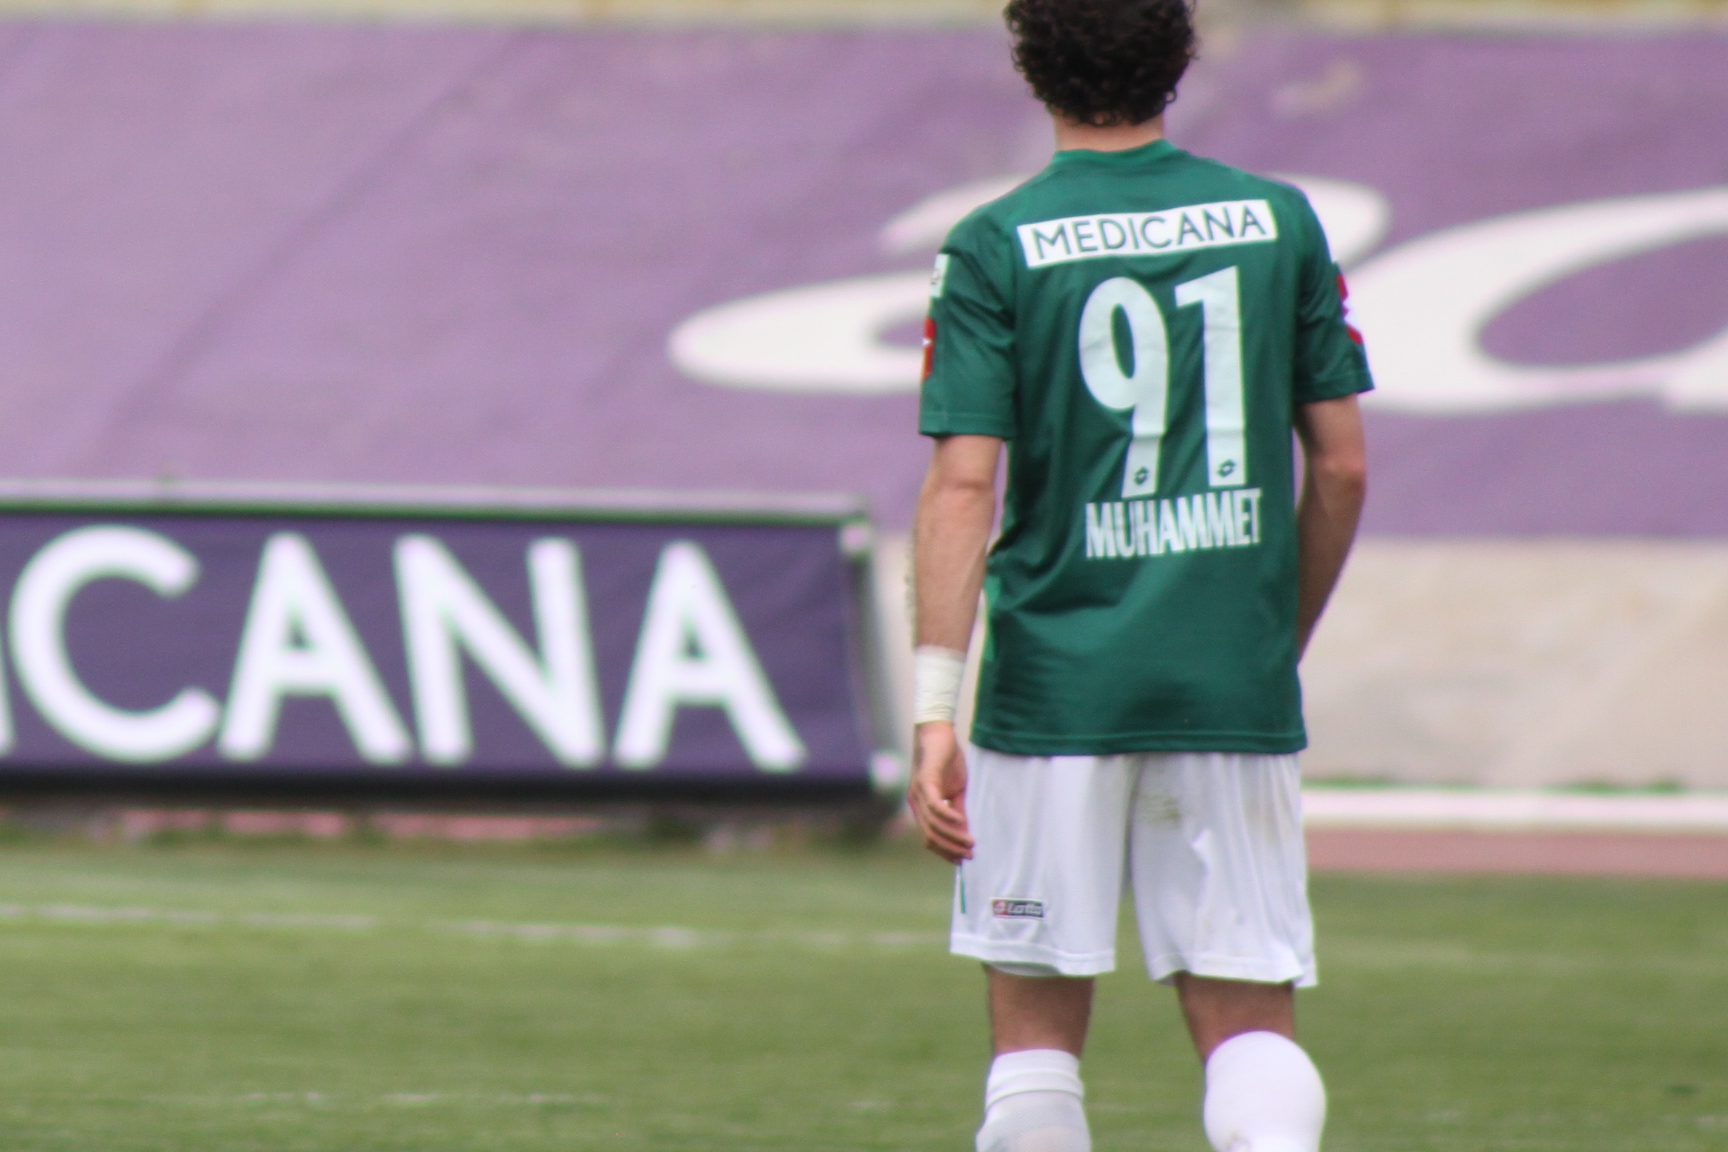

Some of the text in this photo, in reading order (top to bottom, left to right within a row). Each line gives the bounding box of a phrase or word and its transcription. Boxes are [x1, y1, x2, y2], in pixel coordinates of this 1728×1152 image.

[1031, 203, 1267, 263] MEDICANA
[1078, 266, 1247, 499] 91
[1086, 488, 1263, 561] MUHAMMET
